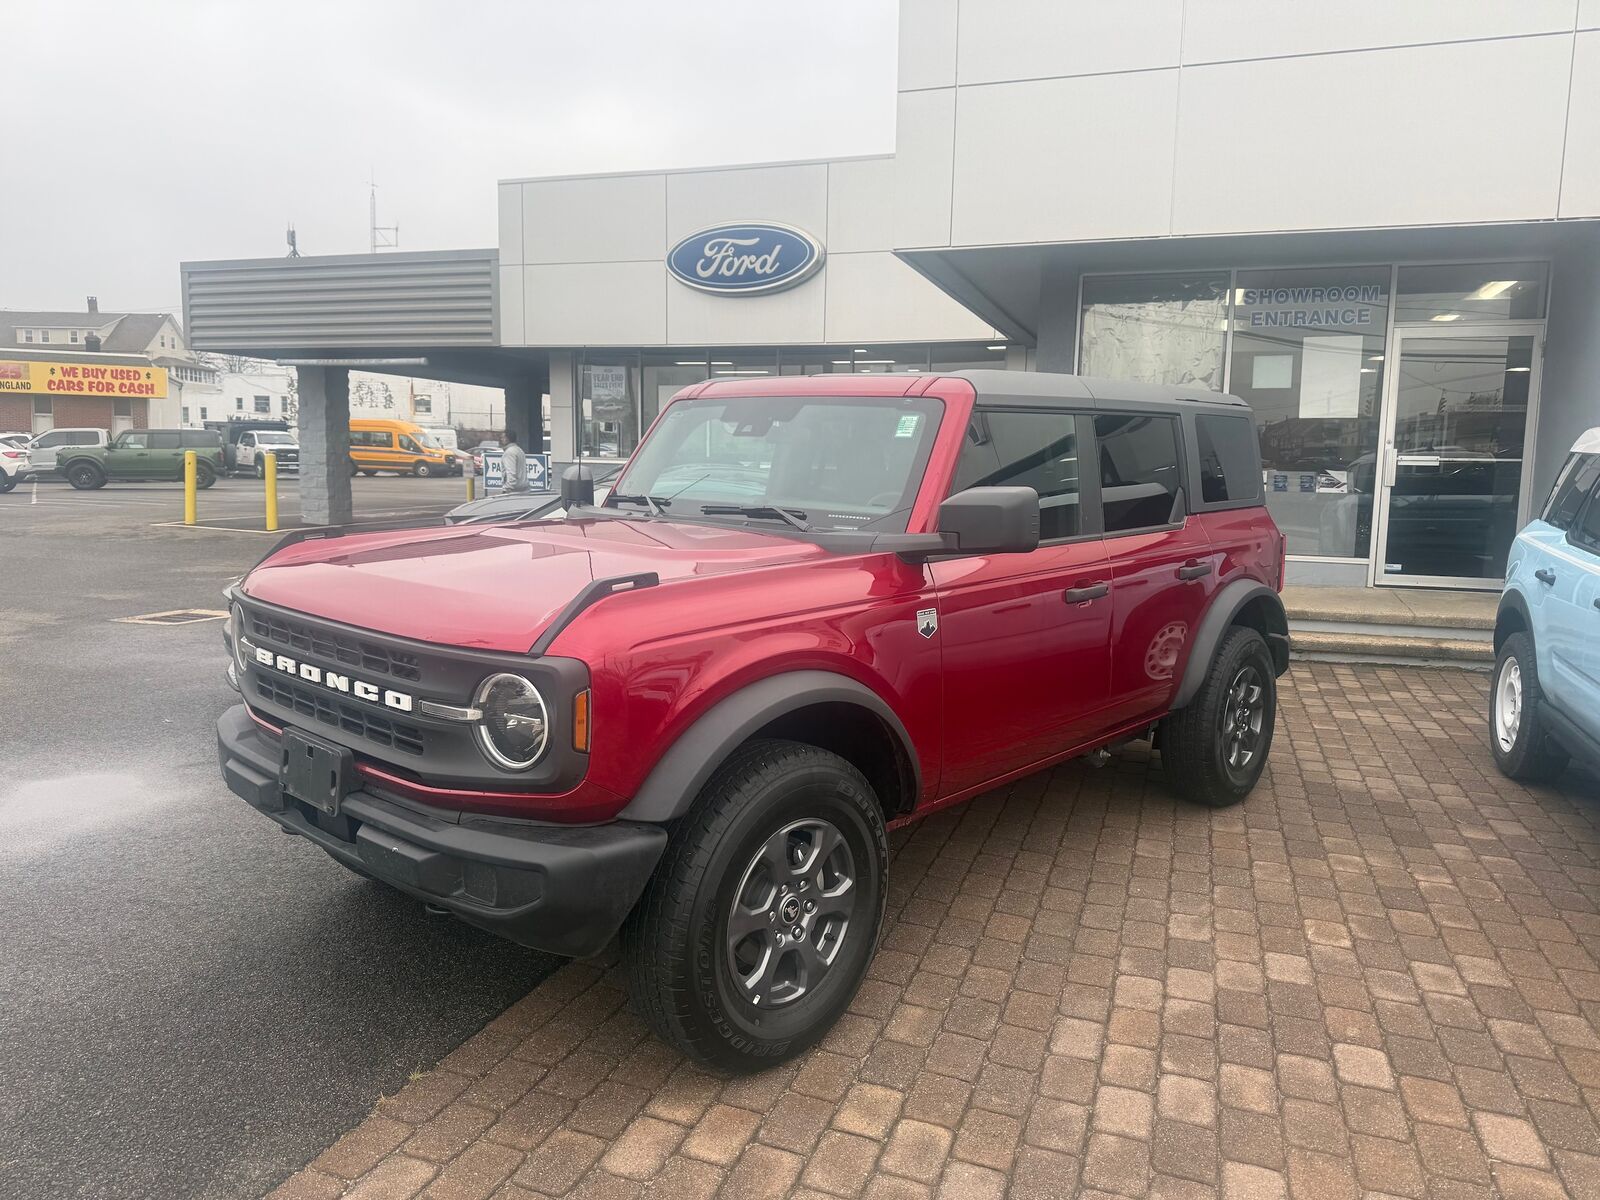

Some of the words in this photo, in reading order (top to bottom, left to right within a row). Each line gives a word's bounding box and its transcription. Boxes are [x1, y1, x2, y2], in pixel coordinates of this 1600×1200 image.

[696, 237, 783, 278] Ford
[1244, 285, 1381, 305] SHOWROOM
[1250, 308, 1372, 327] ENTRANCE
[60, 366, 79, 378] WE
[82, 367, 108, 380] BUY
[110, 368, 141, 381] USED
[0, 380, 32, 390] NGLAND
[47, 379, 84, 392] CARS
[88, 381, 116, 393] FOR
[119, 382, 155, 394] CASH
[256, 647, 412, 712] BRONCO
